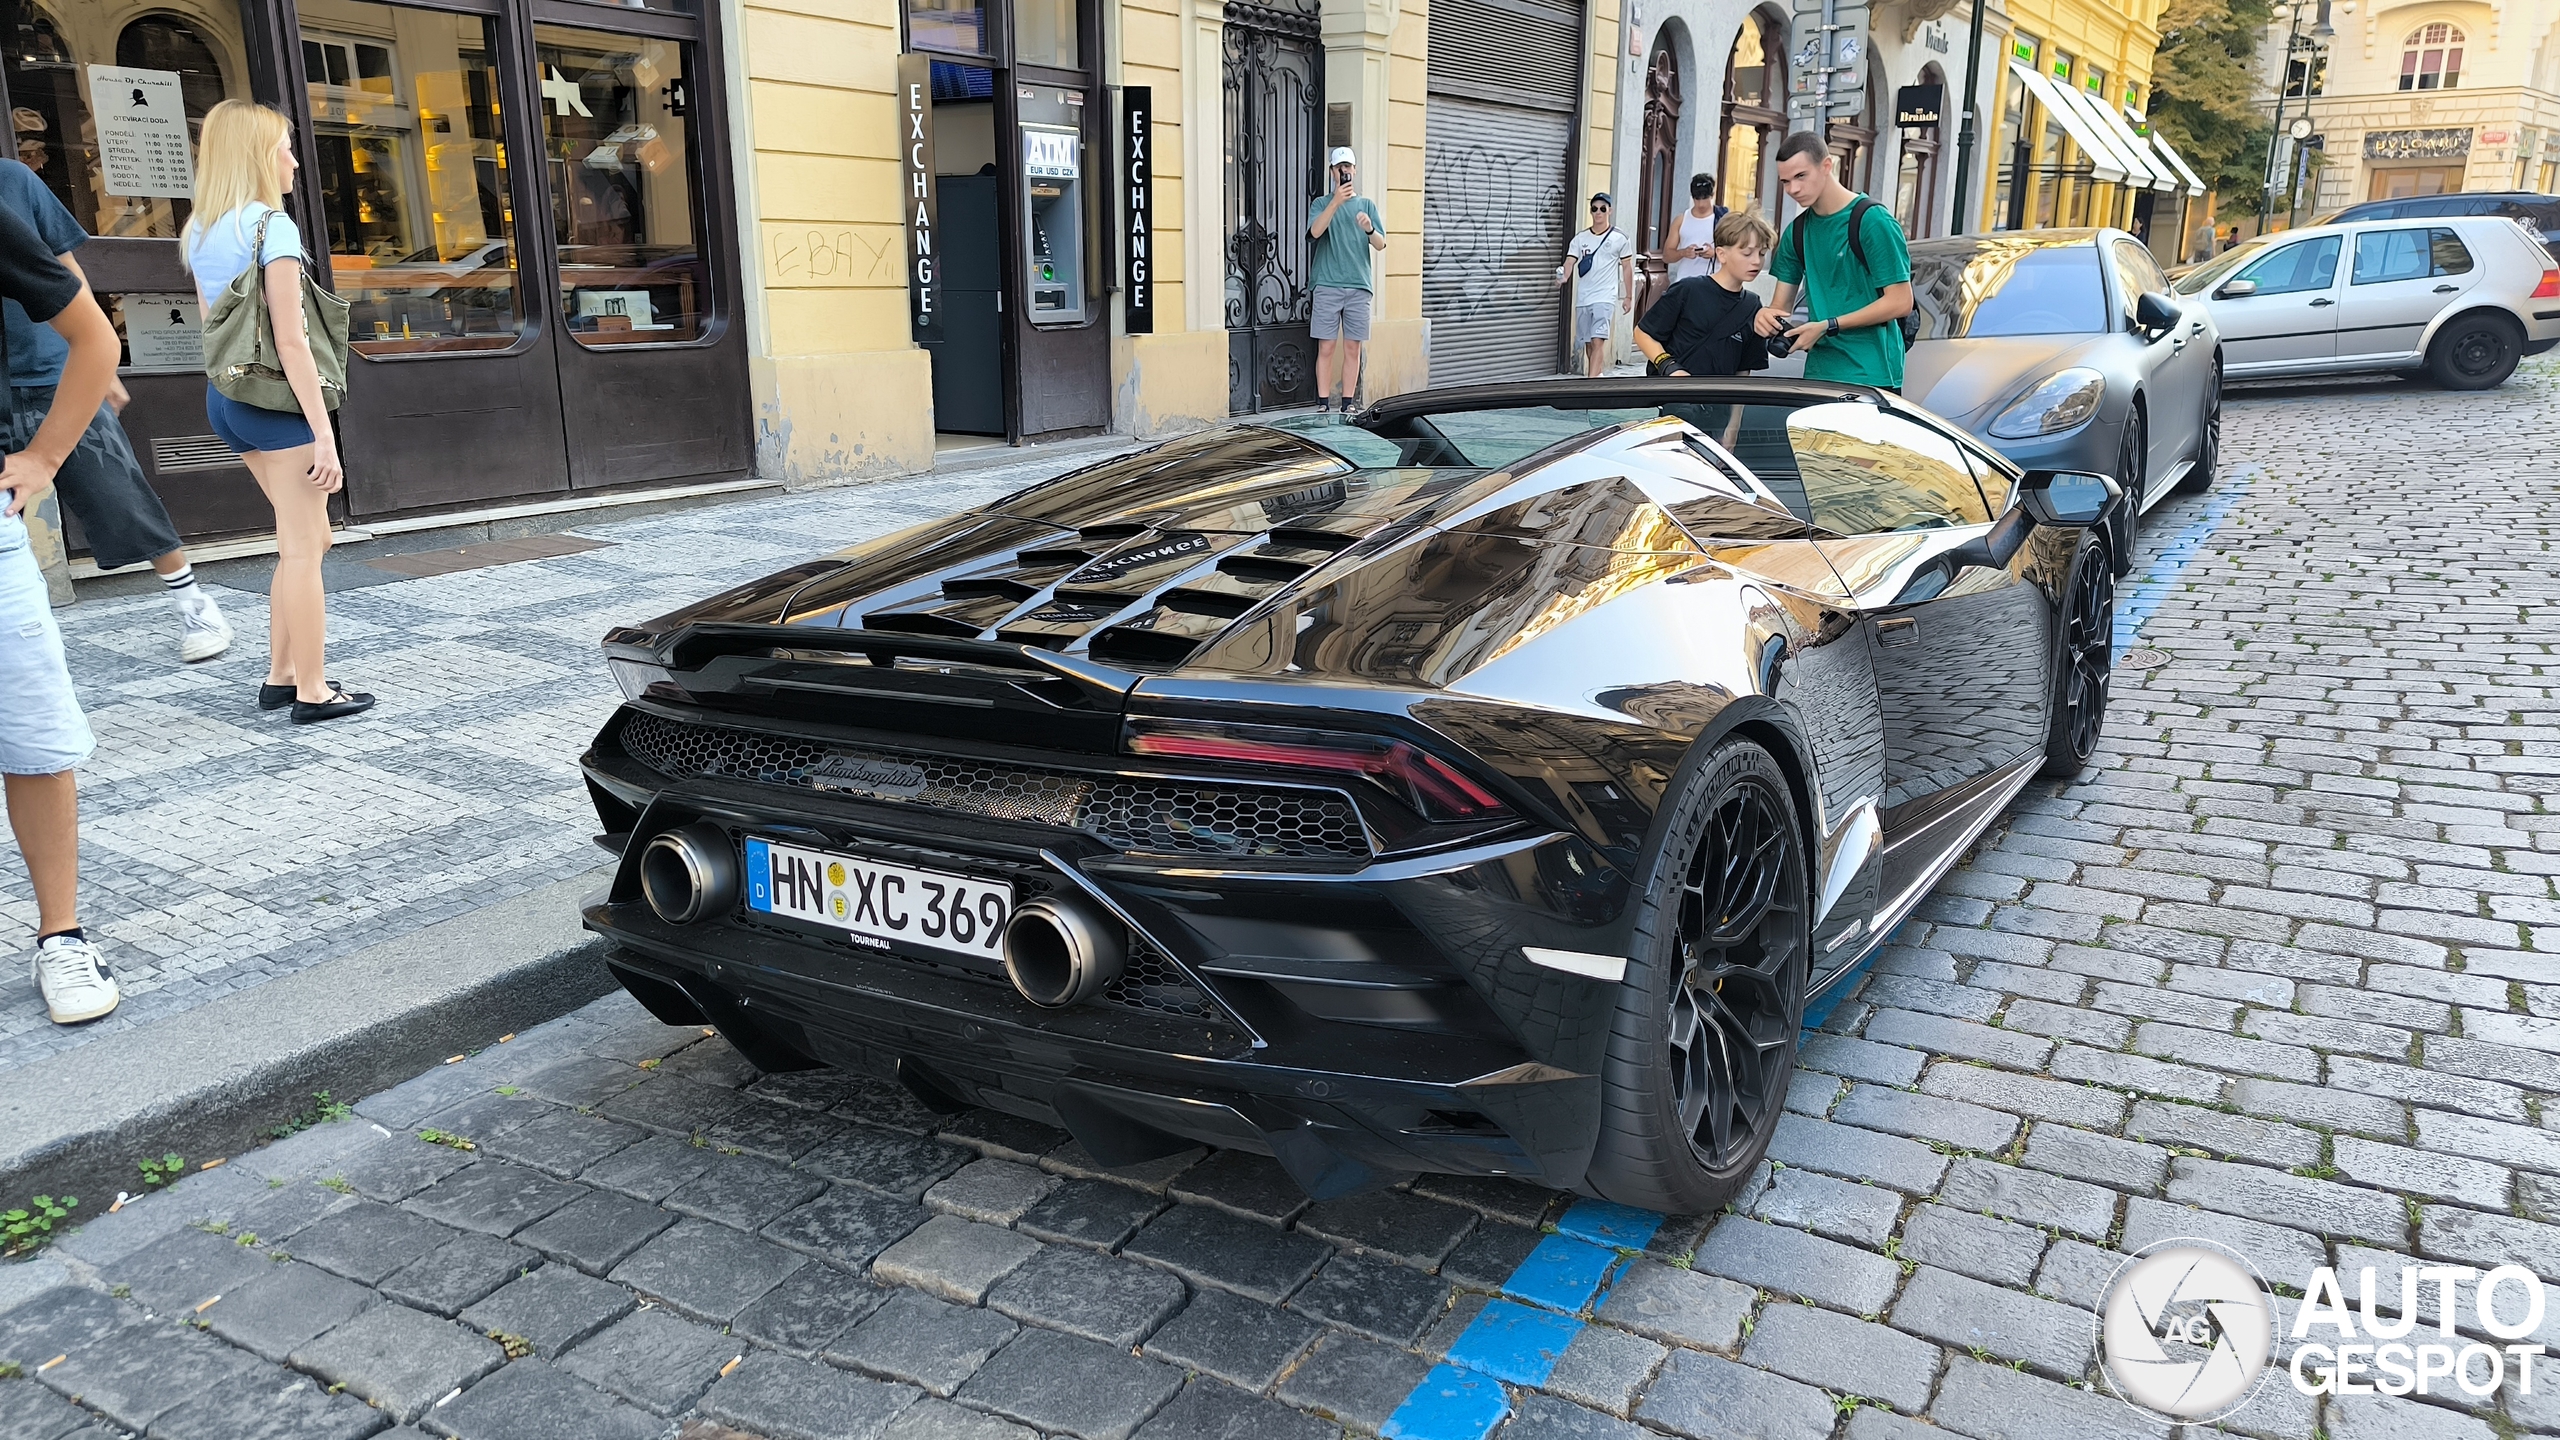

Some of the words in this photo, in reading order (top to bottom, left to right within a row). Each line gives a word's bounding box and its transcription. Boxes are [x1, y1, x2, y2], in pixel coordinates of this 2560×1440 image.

[1900, 110, 1939, 122] Brands
[1028, 136, 1072, 166] ATM
[2376, 138, 2458, 150] BVLGARI
[1031, 166, 1043, 175] EUR
[1047, 167, 1059, 175] USD
[910, 84, 933, 313] EXCHANGE
[1132, 110, 1146, 307] EXCHANGE
[813, 757, 922, 788] Lamborghini
[1697, 754, 1741, 821] MICHELIN
[756, 883, 765, 898] D
[772, 853, 824, 915] HN
[854, 868, 909, 931] XC
[921, 881, 1006, 950] 369
